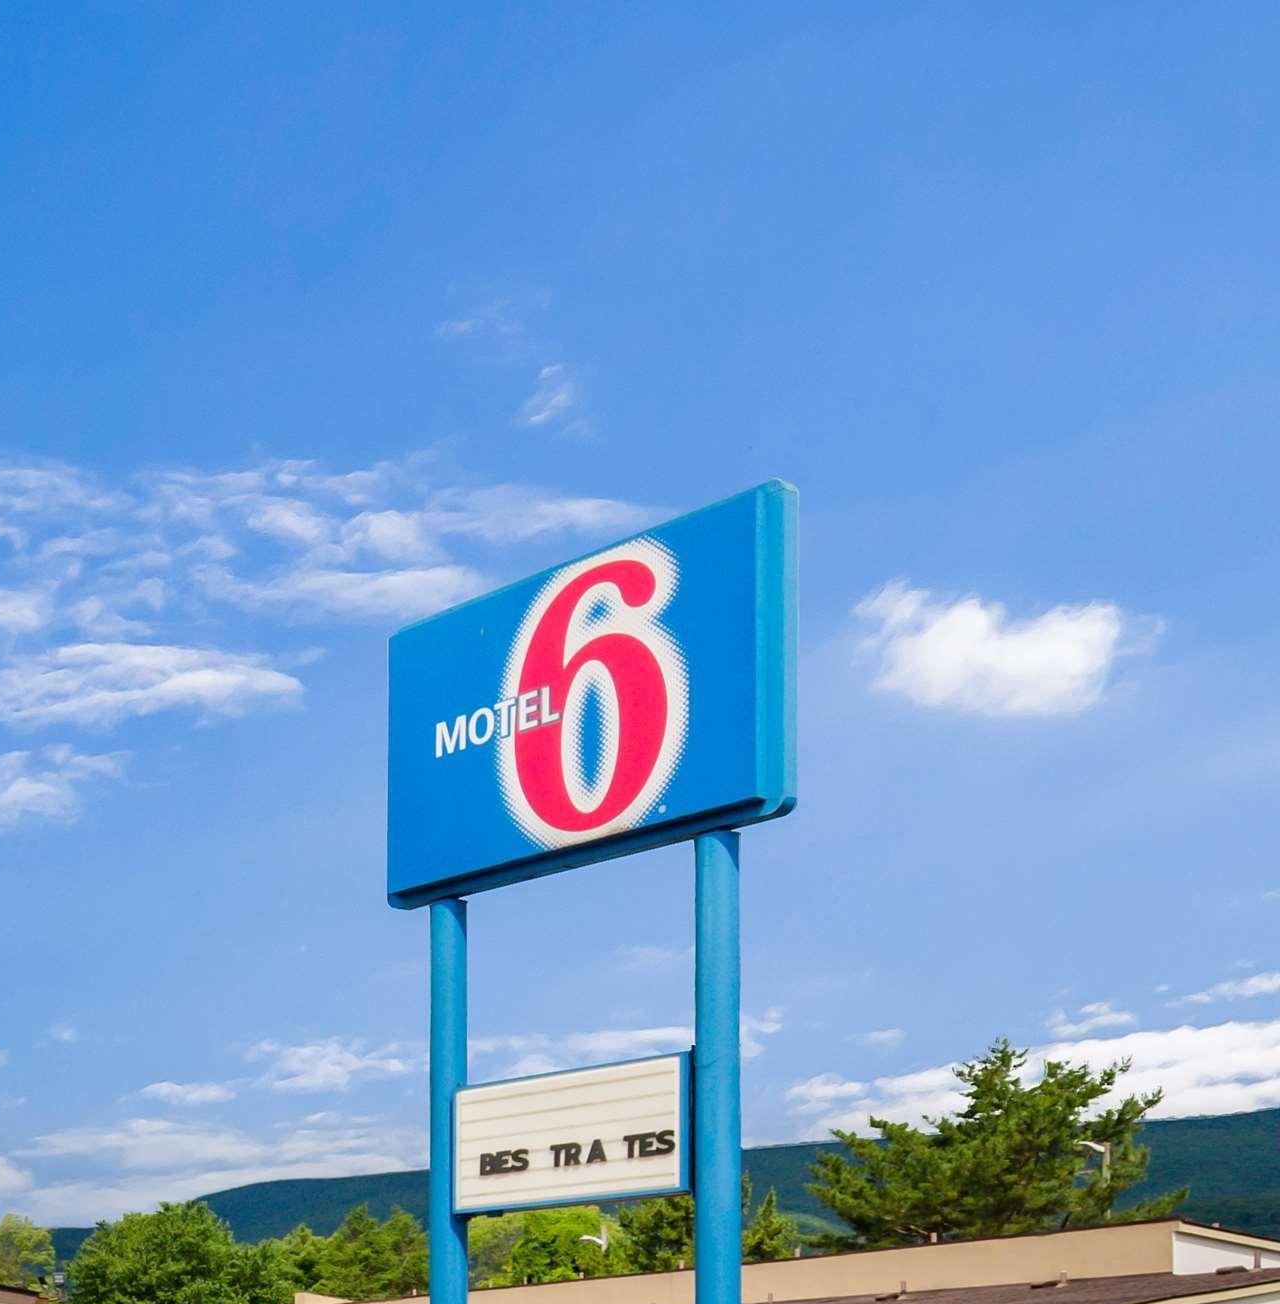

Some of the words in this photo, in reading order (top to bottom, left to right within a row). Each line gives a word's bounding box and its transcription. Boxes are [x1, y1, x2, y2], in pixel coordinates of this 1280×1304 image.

[435, 686, 561, 758] MOTEL
[514, 559, 668, 832] 6
[479, 1148, 529, 1176] BES
[623, 1129, 676, 1159] TES
